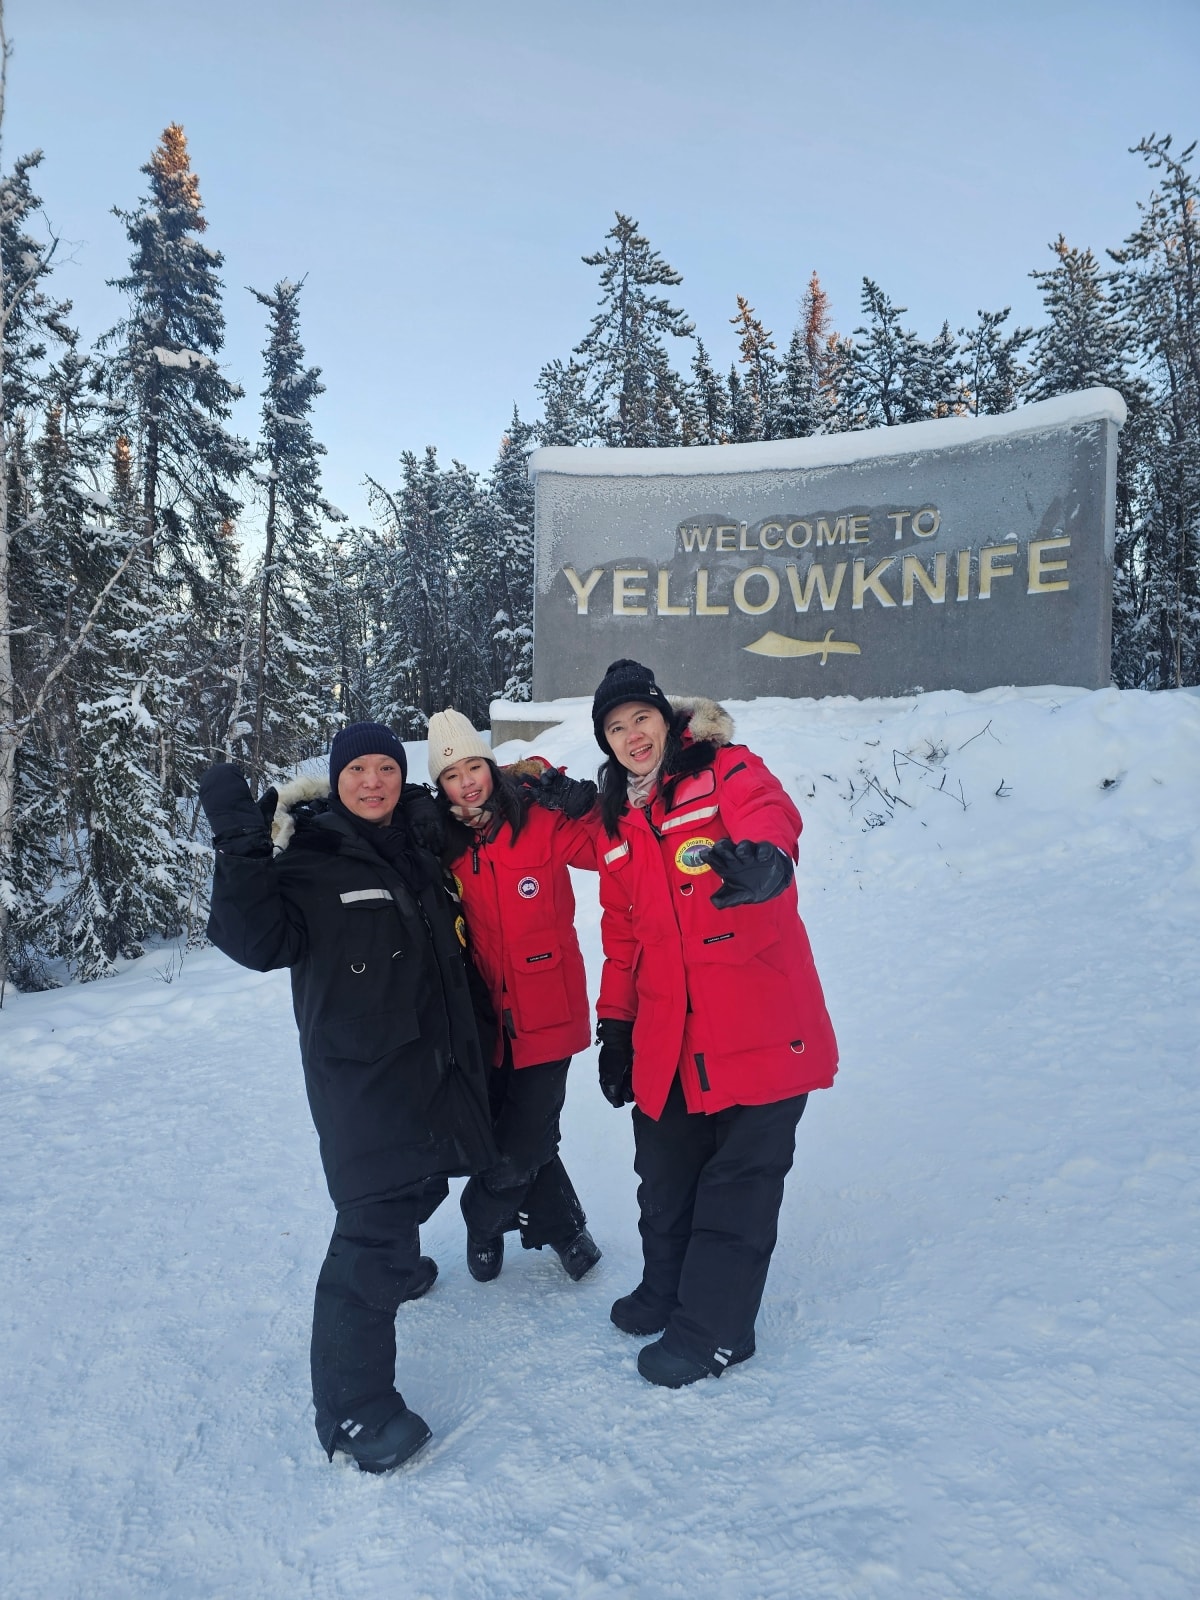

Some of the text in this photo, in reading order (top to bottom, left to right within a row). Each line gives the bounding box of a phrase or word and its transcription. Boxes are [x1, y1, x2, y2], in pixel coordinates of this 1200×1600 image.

[680, 507, 941, 553] WELCOME TO
[562, 536, 1071, 616] YELLOWKNIFE
